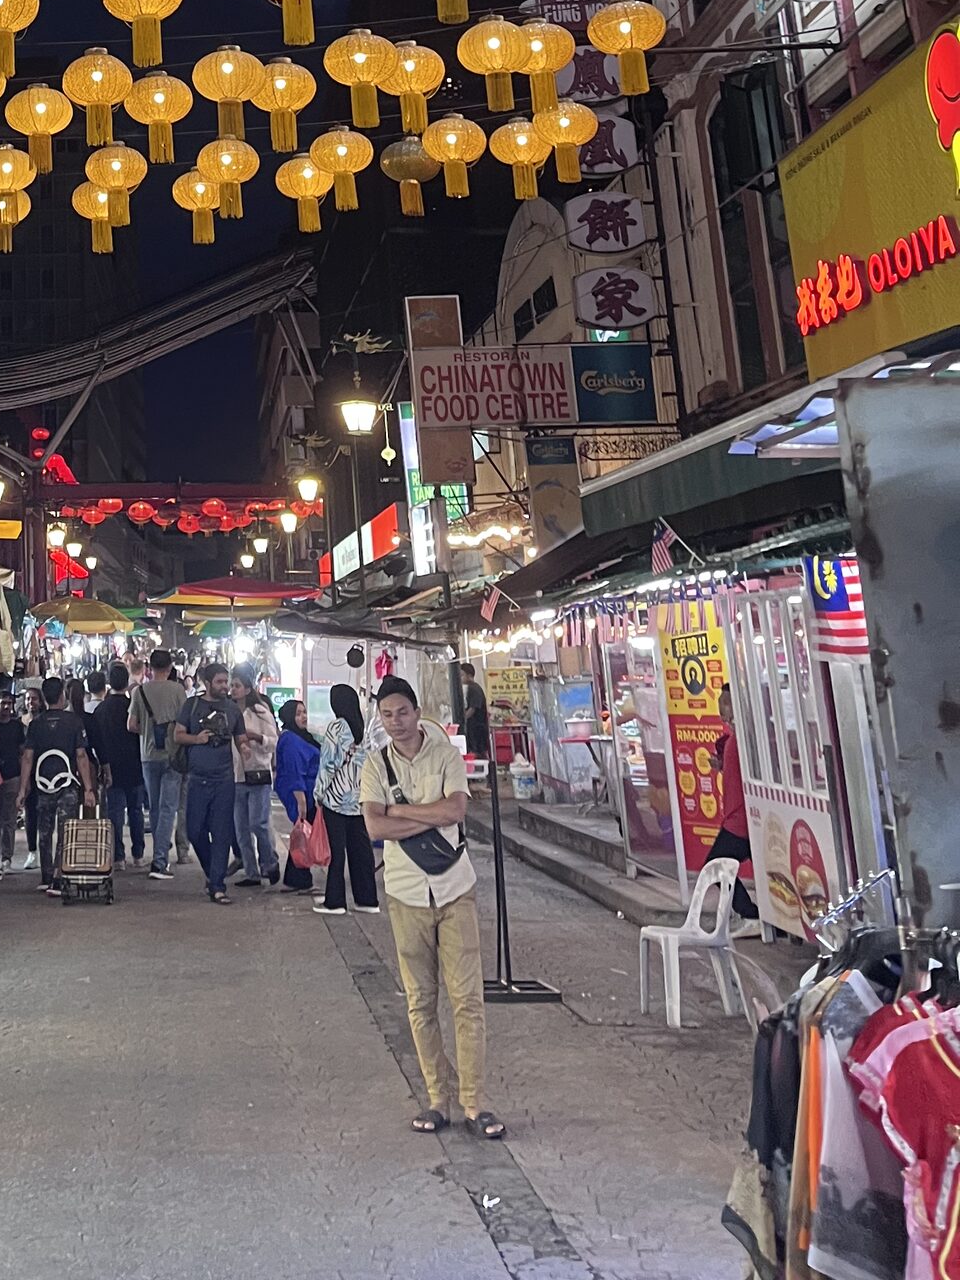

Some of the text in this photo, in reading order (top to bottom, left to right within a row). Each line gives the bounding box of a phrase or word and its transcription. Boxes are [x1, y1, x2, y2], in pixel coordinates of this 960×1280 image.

[544, 4, 581, 23] FUNG
[868, 215, 956, 293] OLOIYA
[454, 351, 530, 363] RESTORAN
[420, 362, 566, 395] CHINATOWN
[580, 370, 645, 393] Carlsberg
[421, 392, 570, 422] FOOD CENTRE
